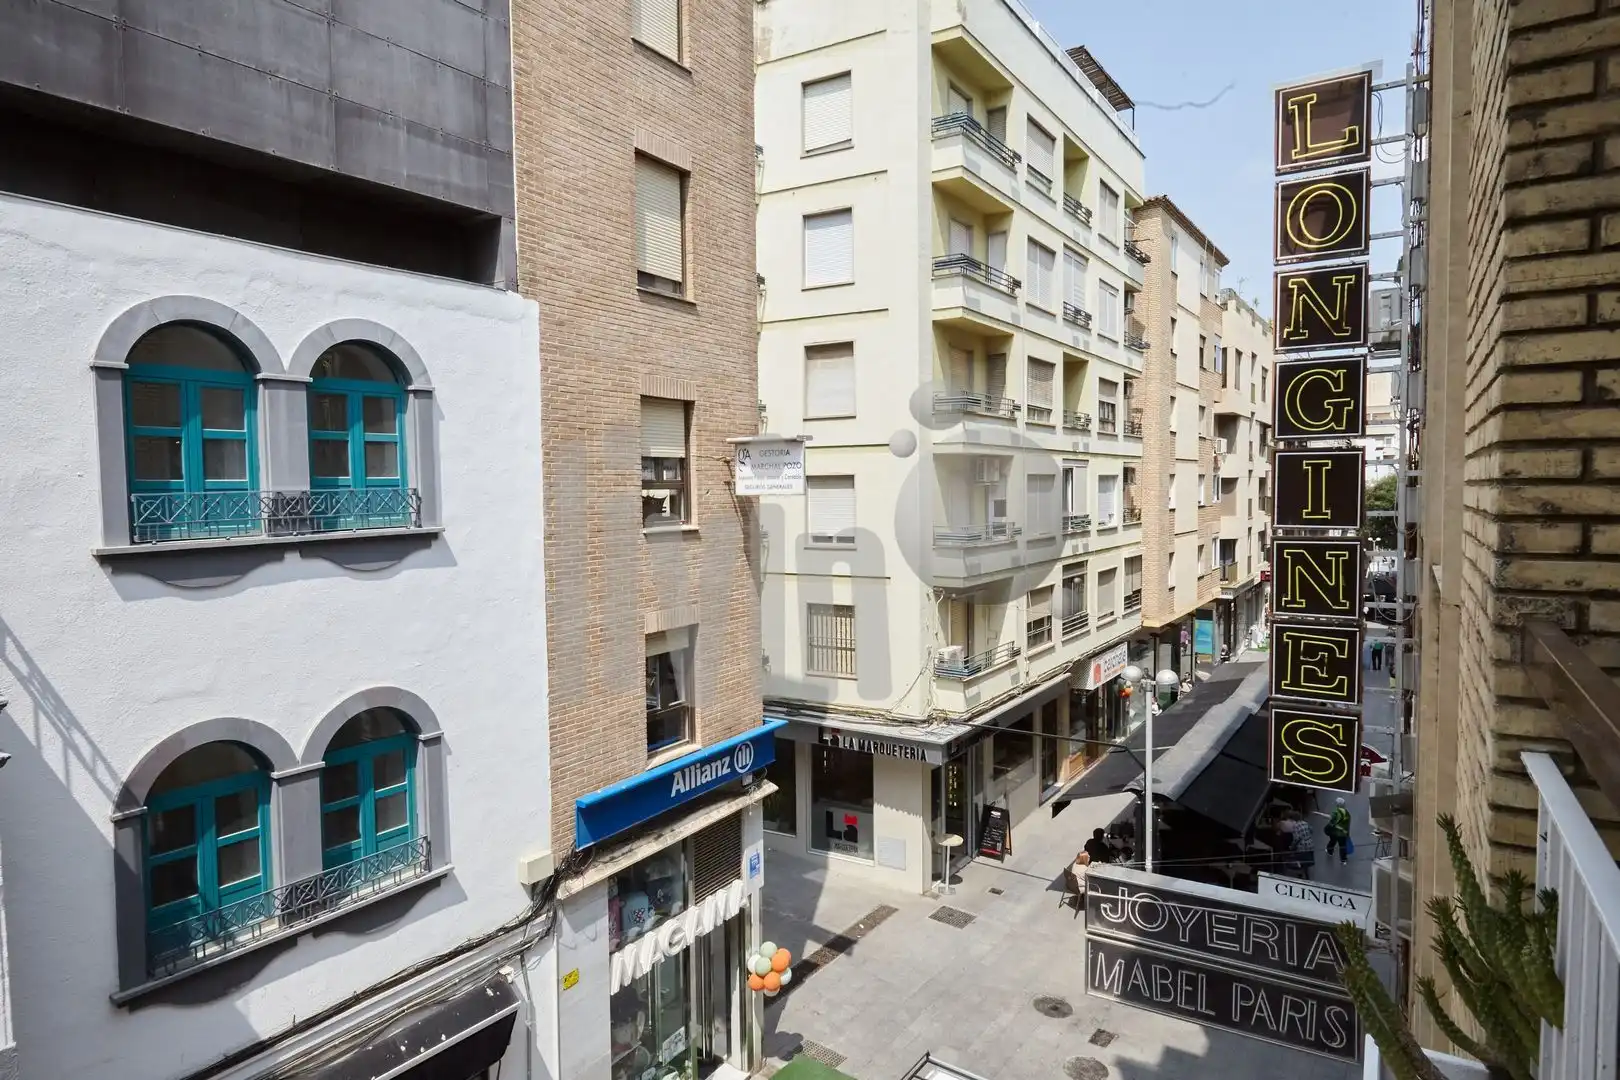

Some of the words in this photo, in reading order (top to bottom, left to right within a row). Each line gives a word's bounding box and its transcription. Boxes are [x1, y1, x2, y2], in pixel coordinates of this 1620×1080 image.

[783, 461, 802, 469] POZO
[1282, 93, 1359, 783] LONGINES
[670, 755, 731, 798] Allianz
[1275, 882, 1357, 911] CLINICA
[1100, 886, 1348, 974] JOYERIA
[1094, 952, 1216, 1017] MABEL
[1232, 982, 1349, 1049] PARIS
